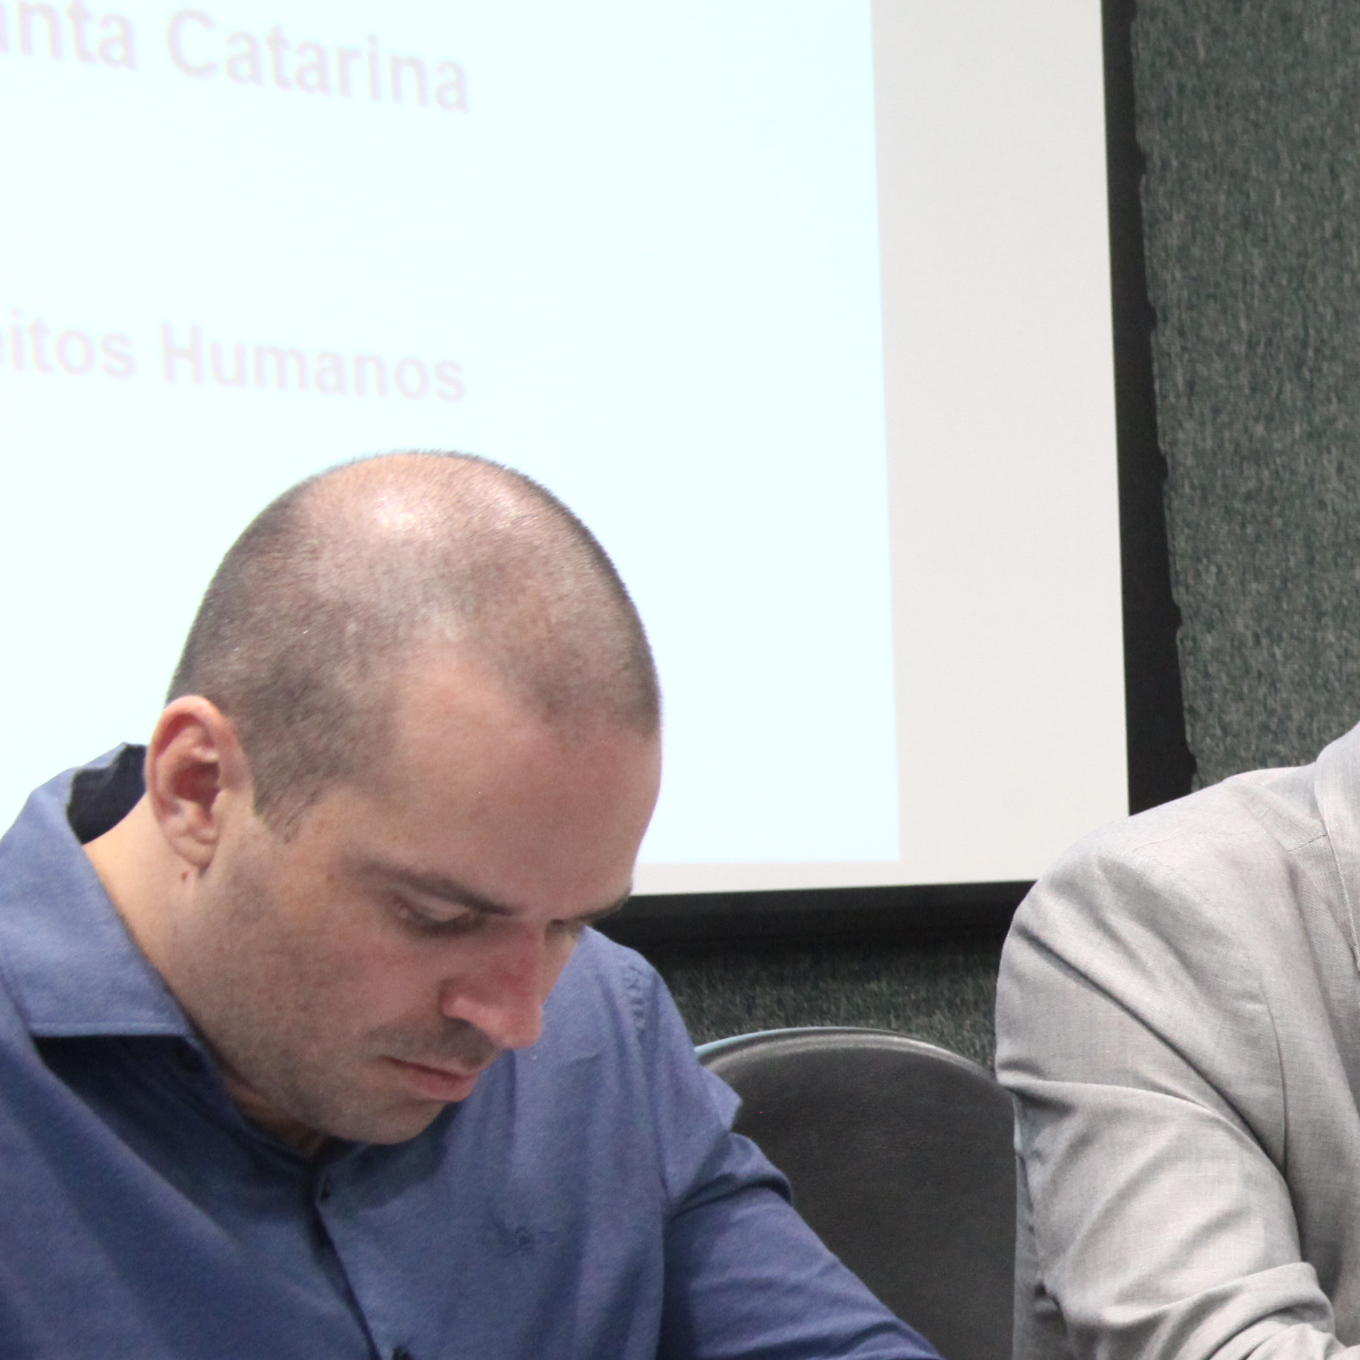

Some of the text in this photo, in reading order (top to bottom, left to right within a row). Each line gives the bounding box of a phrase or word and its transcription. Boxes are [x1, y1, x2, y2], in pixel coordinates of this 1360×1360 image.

[0, 0, 469, 113] nta Catarina
[0, 308, 466, 403] itos Humanos
